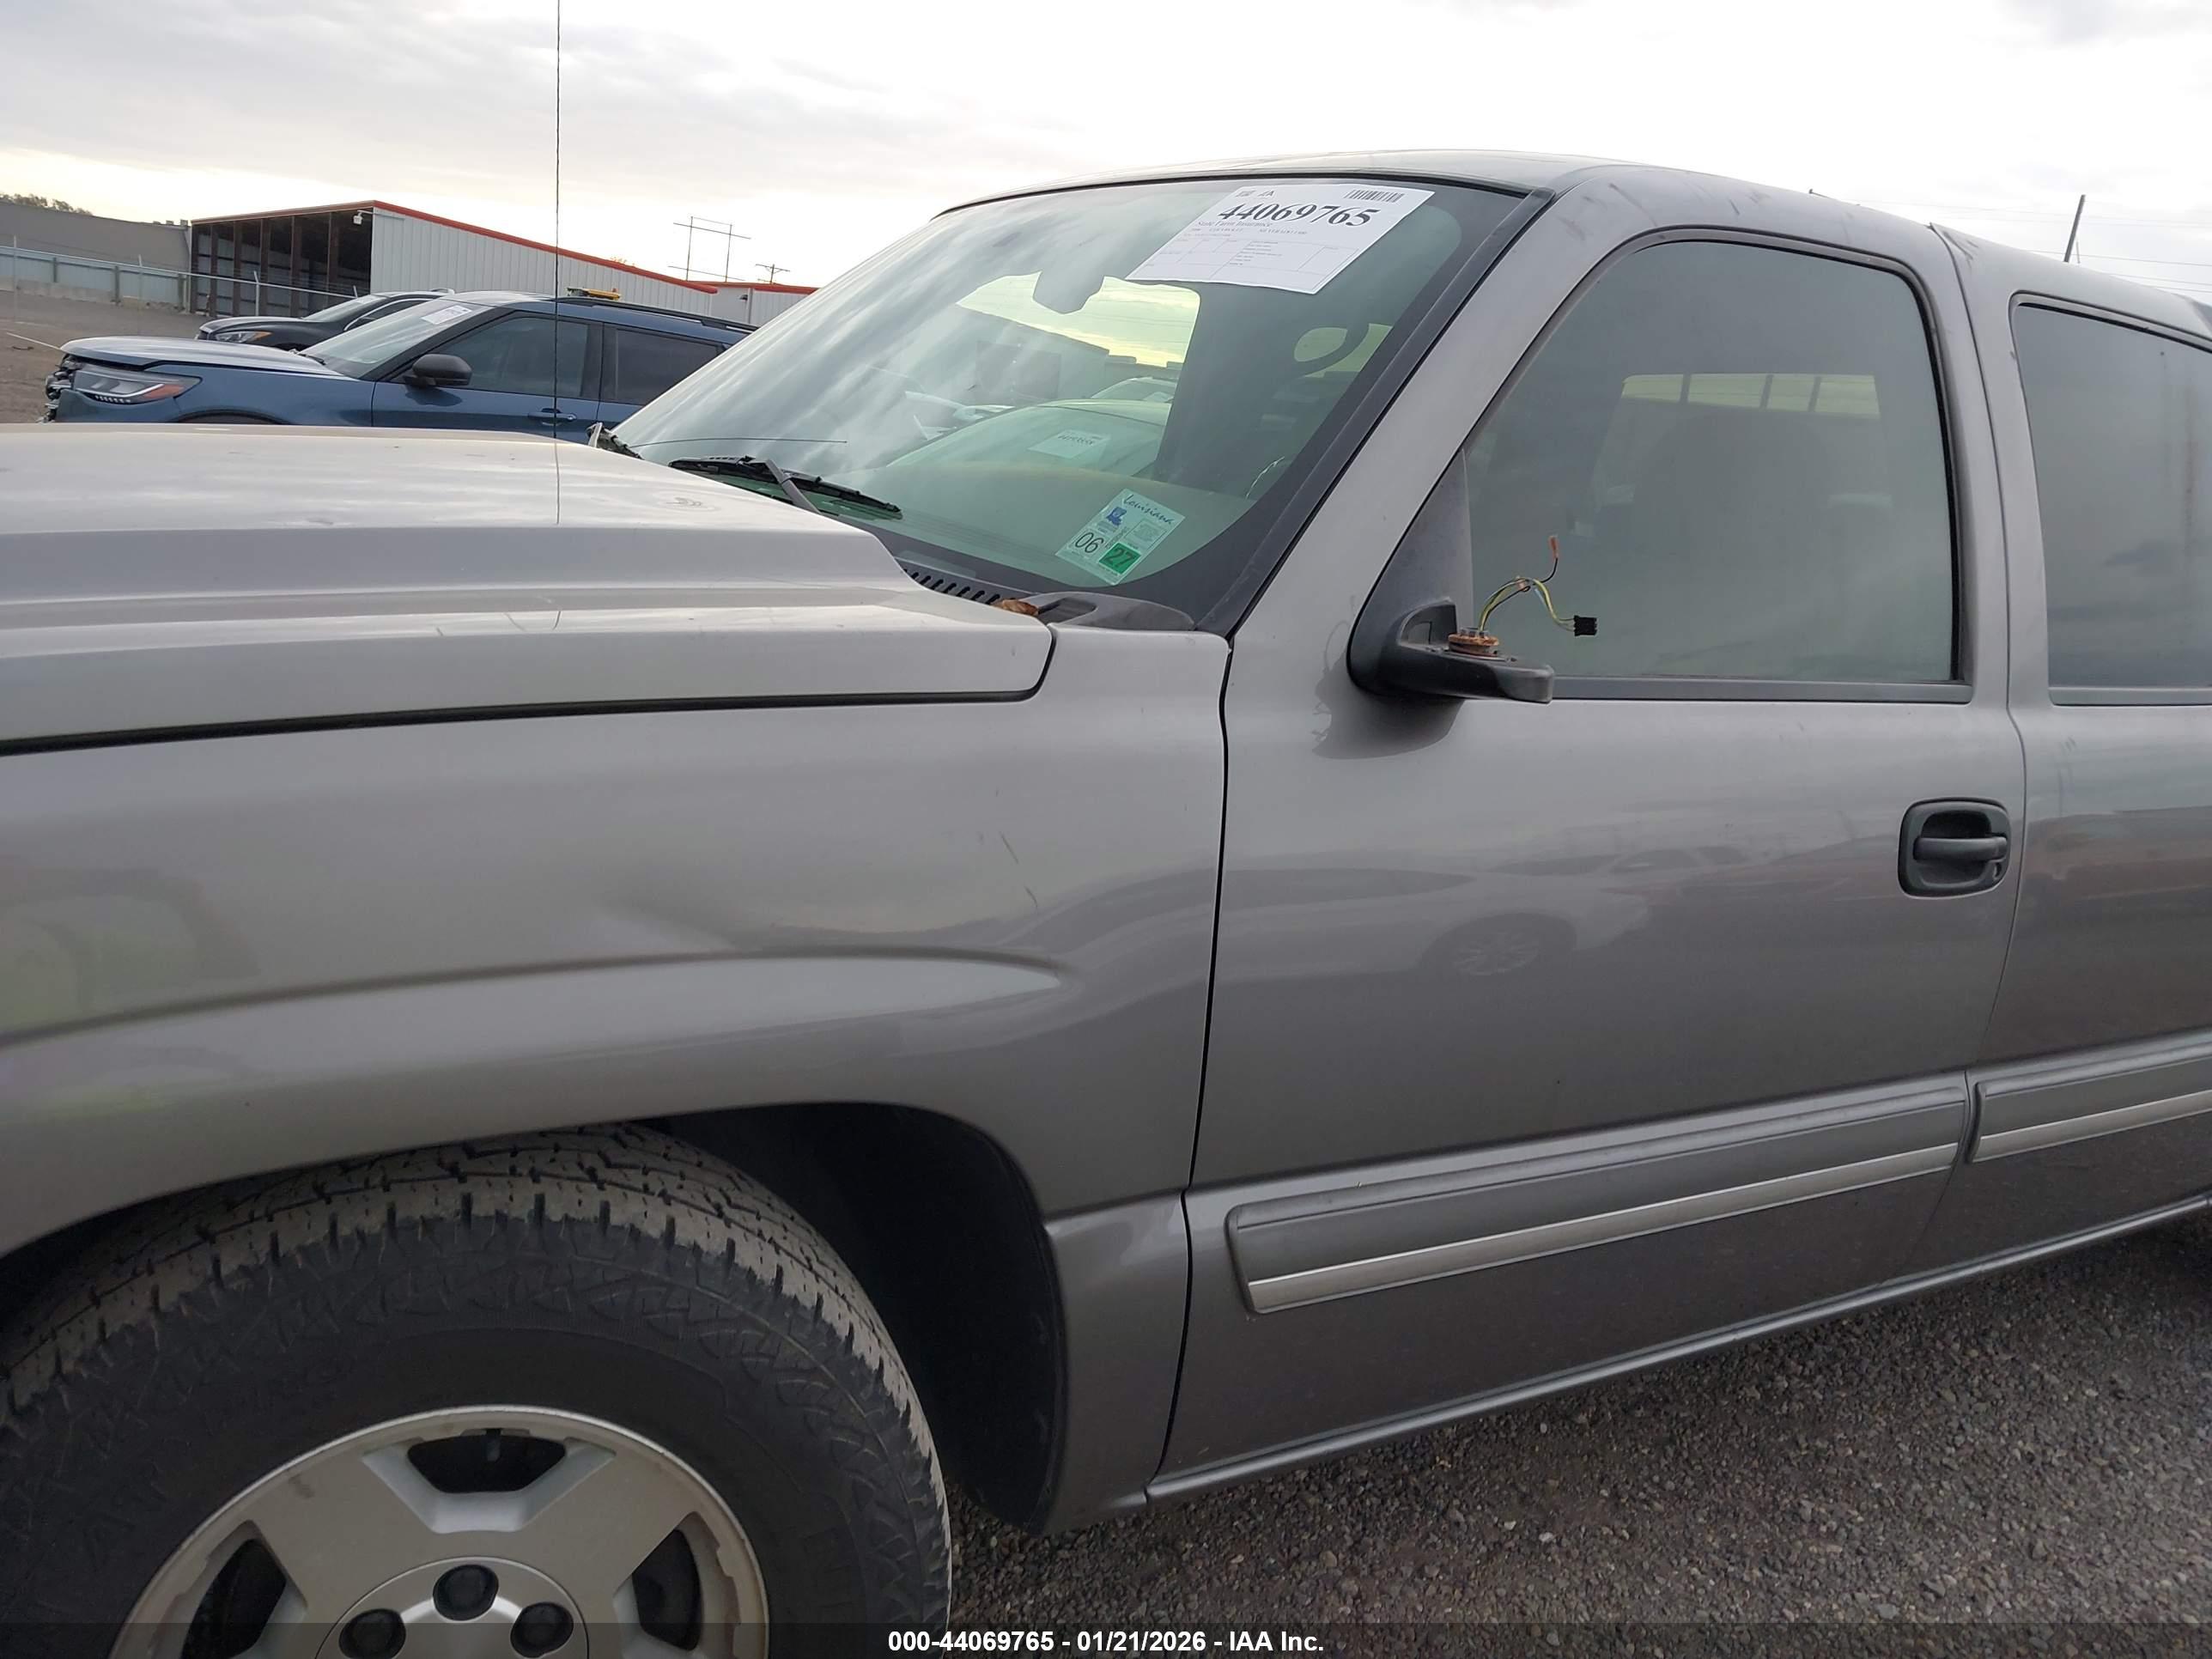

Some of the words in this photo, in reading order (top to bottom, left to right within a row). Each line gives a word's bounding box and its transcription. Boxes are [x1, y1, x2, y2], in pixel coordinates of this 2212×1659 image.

[1218, 203, 1382, 227] 44069765
[1123, 494, 1176, 526] Louisiana
[1074, 532, 1104, 554] 06
[1103, 546, 1136, 568] 27
